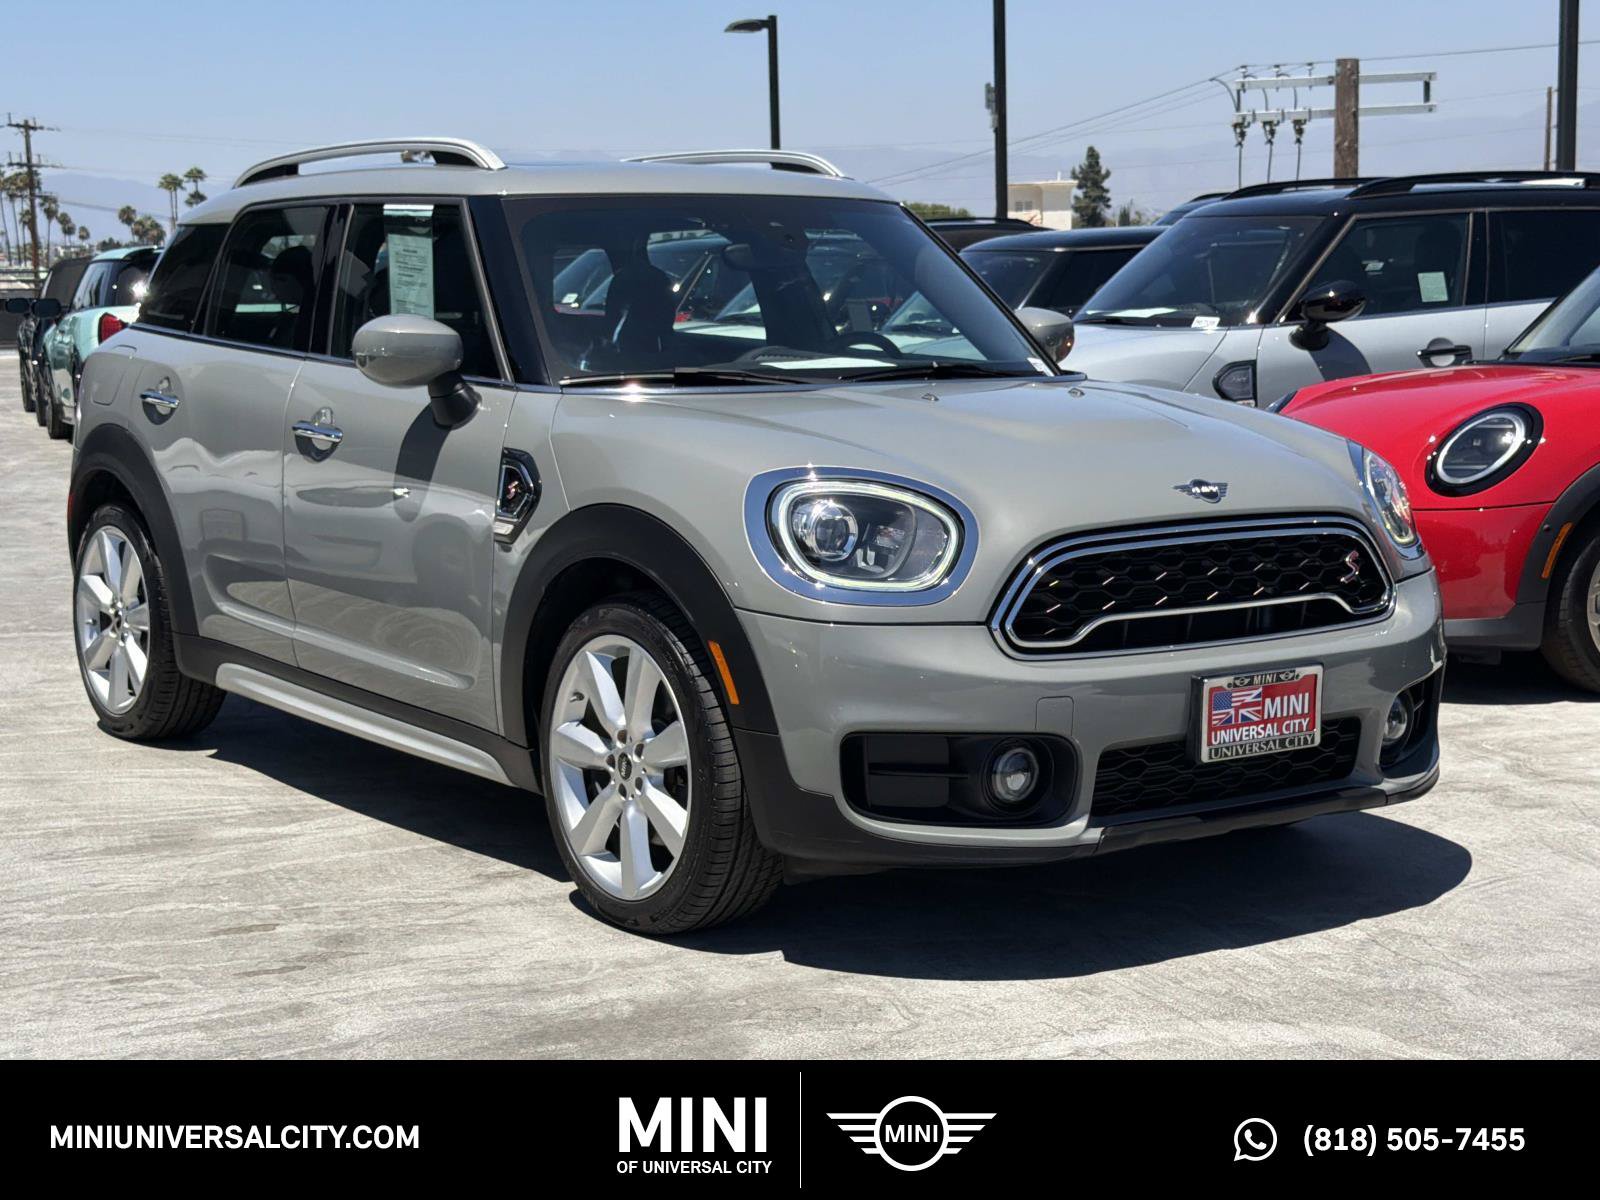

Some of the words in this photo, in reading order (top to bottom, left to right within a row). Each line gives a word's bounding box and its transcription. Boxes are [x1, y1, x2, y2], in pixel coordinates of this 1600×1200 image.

[1253, 673, 1277, 686] MINI
[1263, 692, 1310, 720] MINI
[1211, 722, 1281, 745] UNIVERSAL
[1282, 717, 1310, 734] CITY
[1211, 739, 1281, 759] UNIVERSAL
[1285, 733, 1314, 748] CITY
